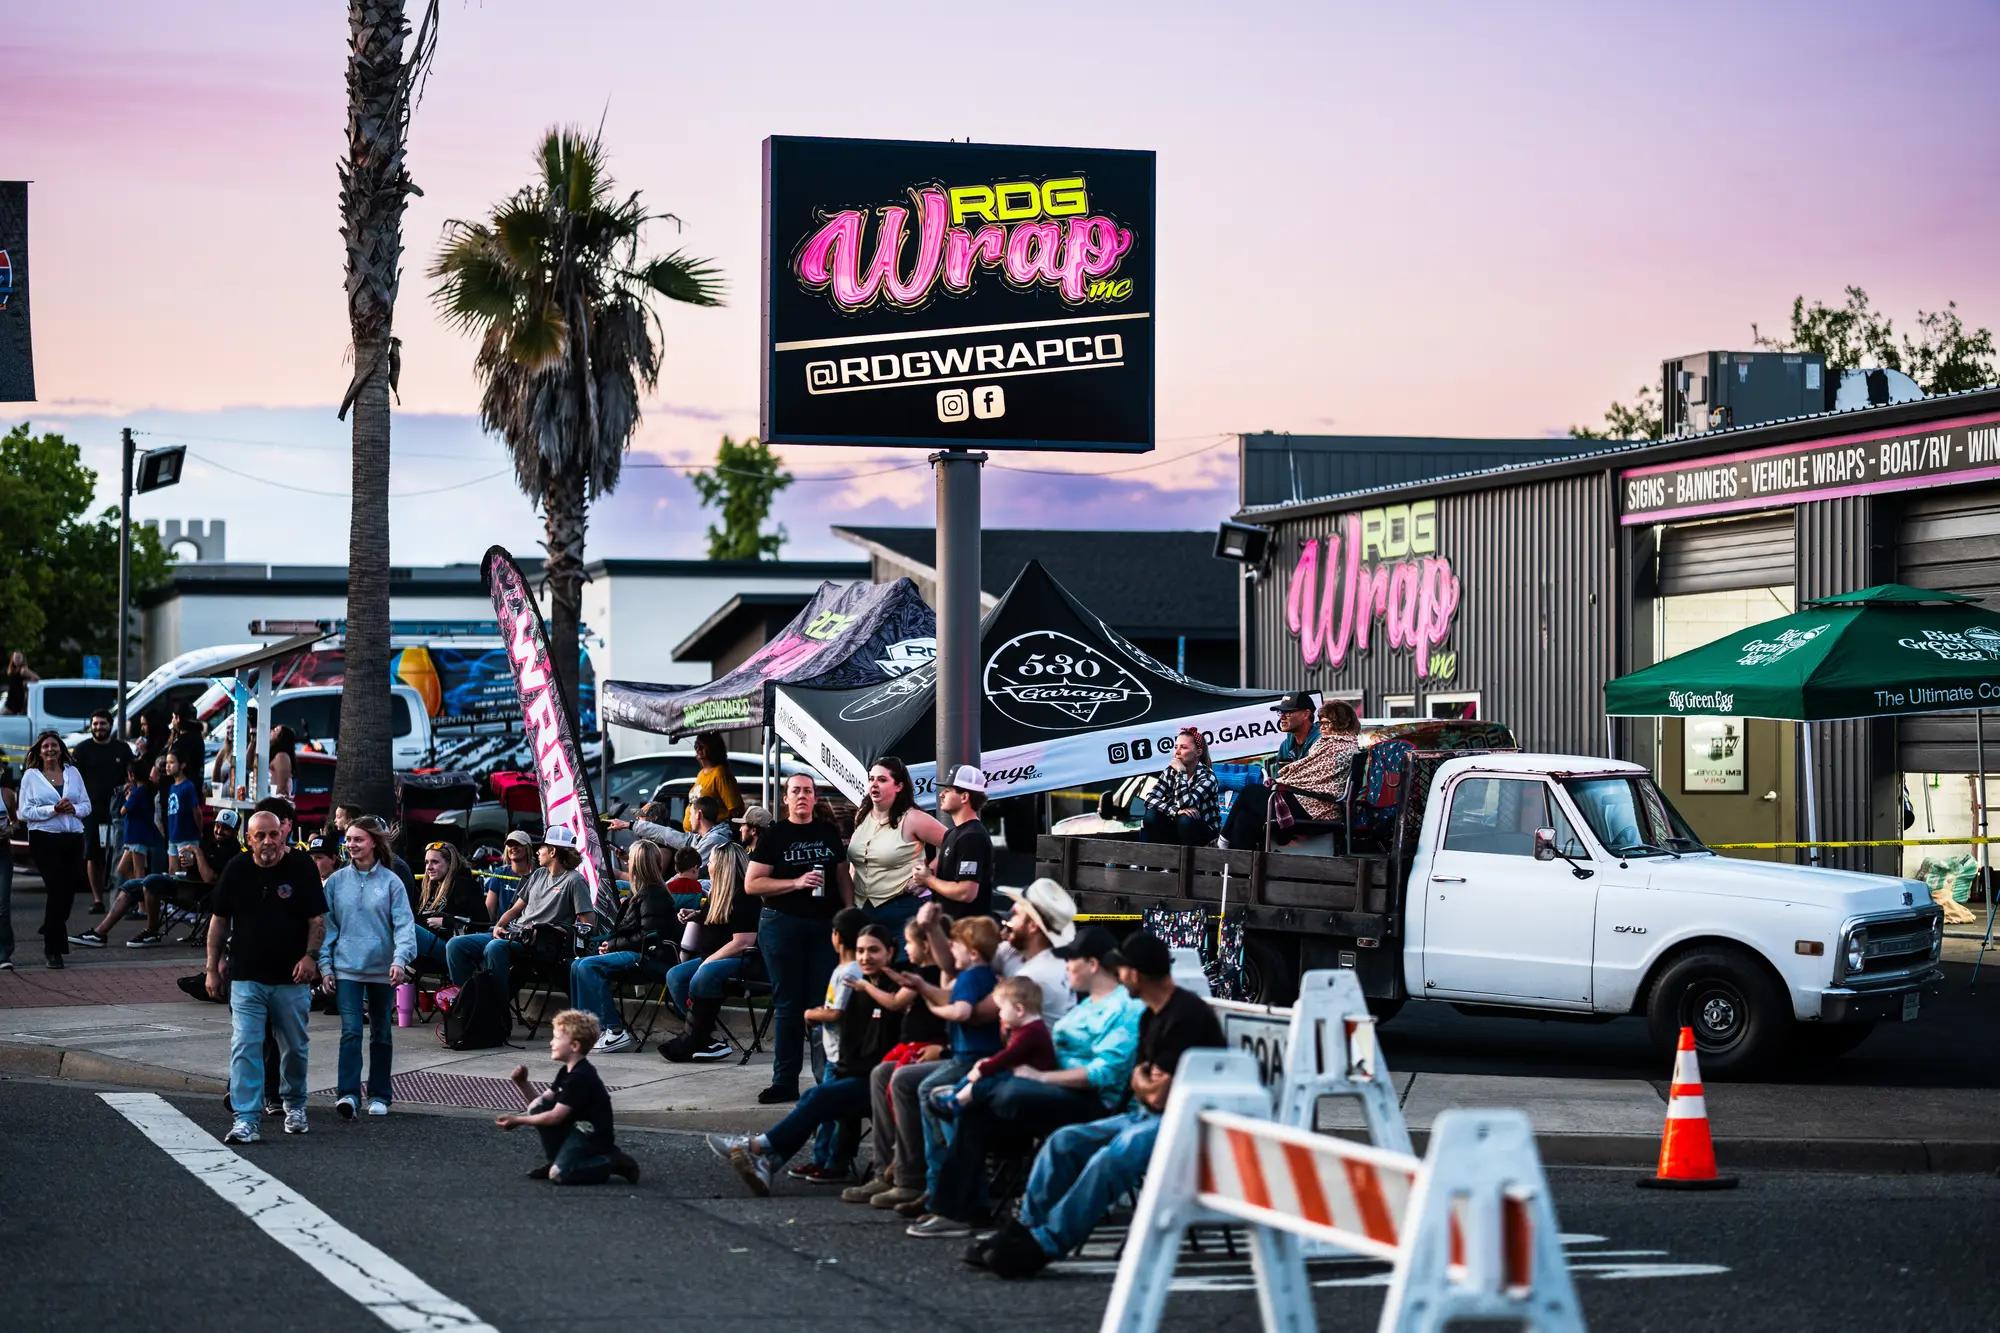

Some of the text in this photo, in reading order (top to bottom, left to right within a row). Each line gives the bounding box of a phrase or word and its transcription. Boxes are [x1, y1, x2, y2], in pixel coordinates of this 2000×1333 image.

[950, 177, 1088, 224] RDG
[797, 183, 1134, 306] Wrap
[805, 333, 1125, 394] @RDGWRAPCO
[1627, 477, 1665, 510] SIGNS
[1676, 466, 1738, 504] BANNERS
[1751, 456, 1809, 493] VEHICLE
[1812, 447, 1865, 485] WRAPS
[1880, 434, 1951, 476] BOAT/RV
[1968, 427, 2000, 463] WIN
[1362, 500, 1436, 561] RDG
[1286, 512, 1461, 680] Wrap
[1920, 630, 1968, 643] Big
[1018, 653, 1101, 678] 530
[1018, 687, 1121, 700] Garage
[1668, 691, 1734, 712] Big Green Egg
[1874, 690, 1905, 707] The
[1909, 686, 1974, 705] Ultimate
[783, 847, 835, 861] ULTRA
